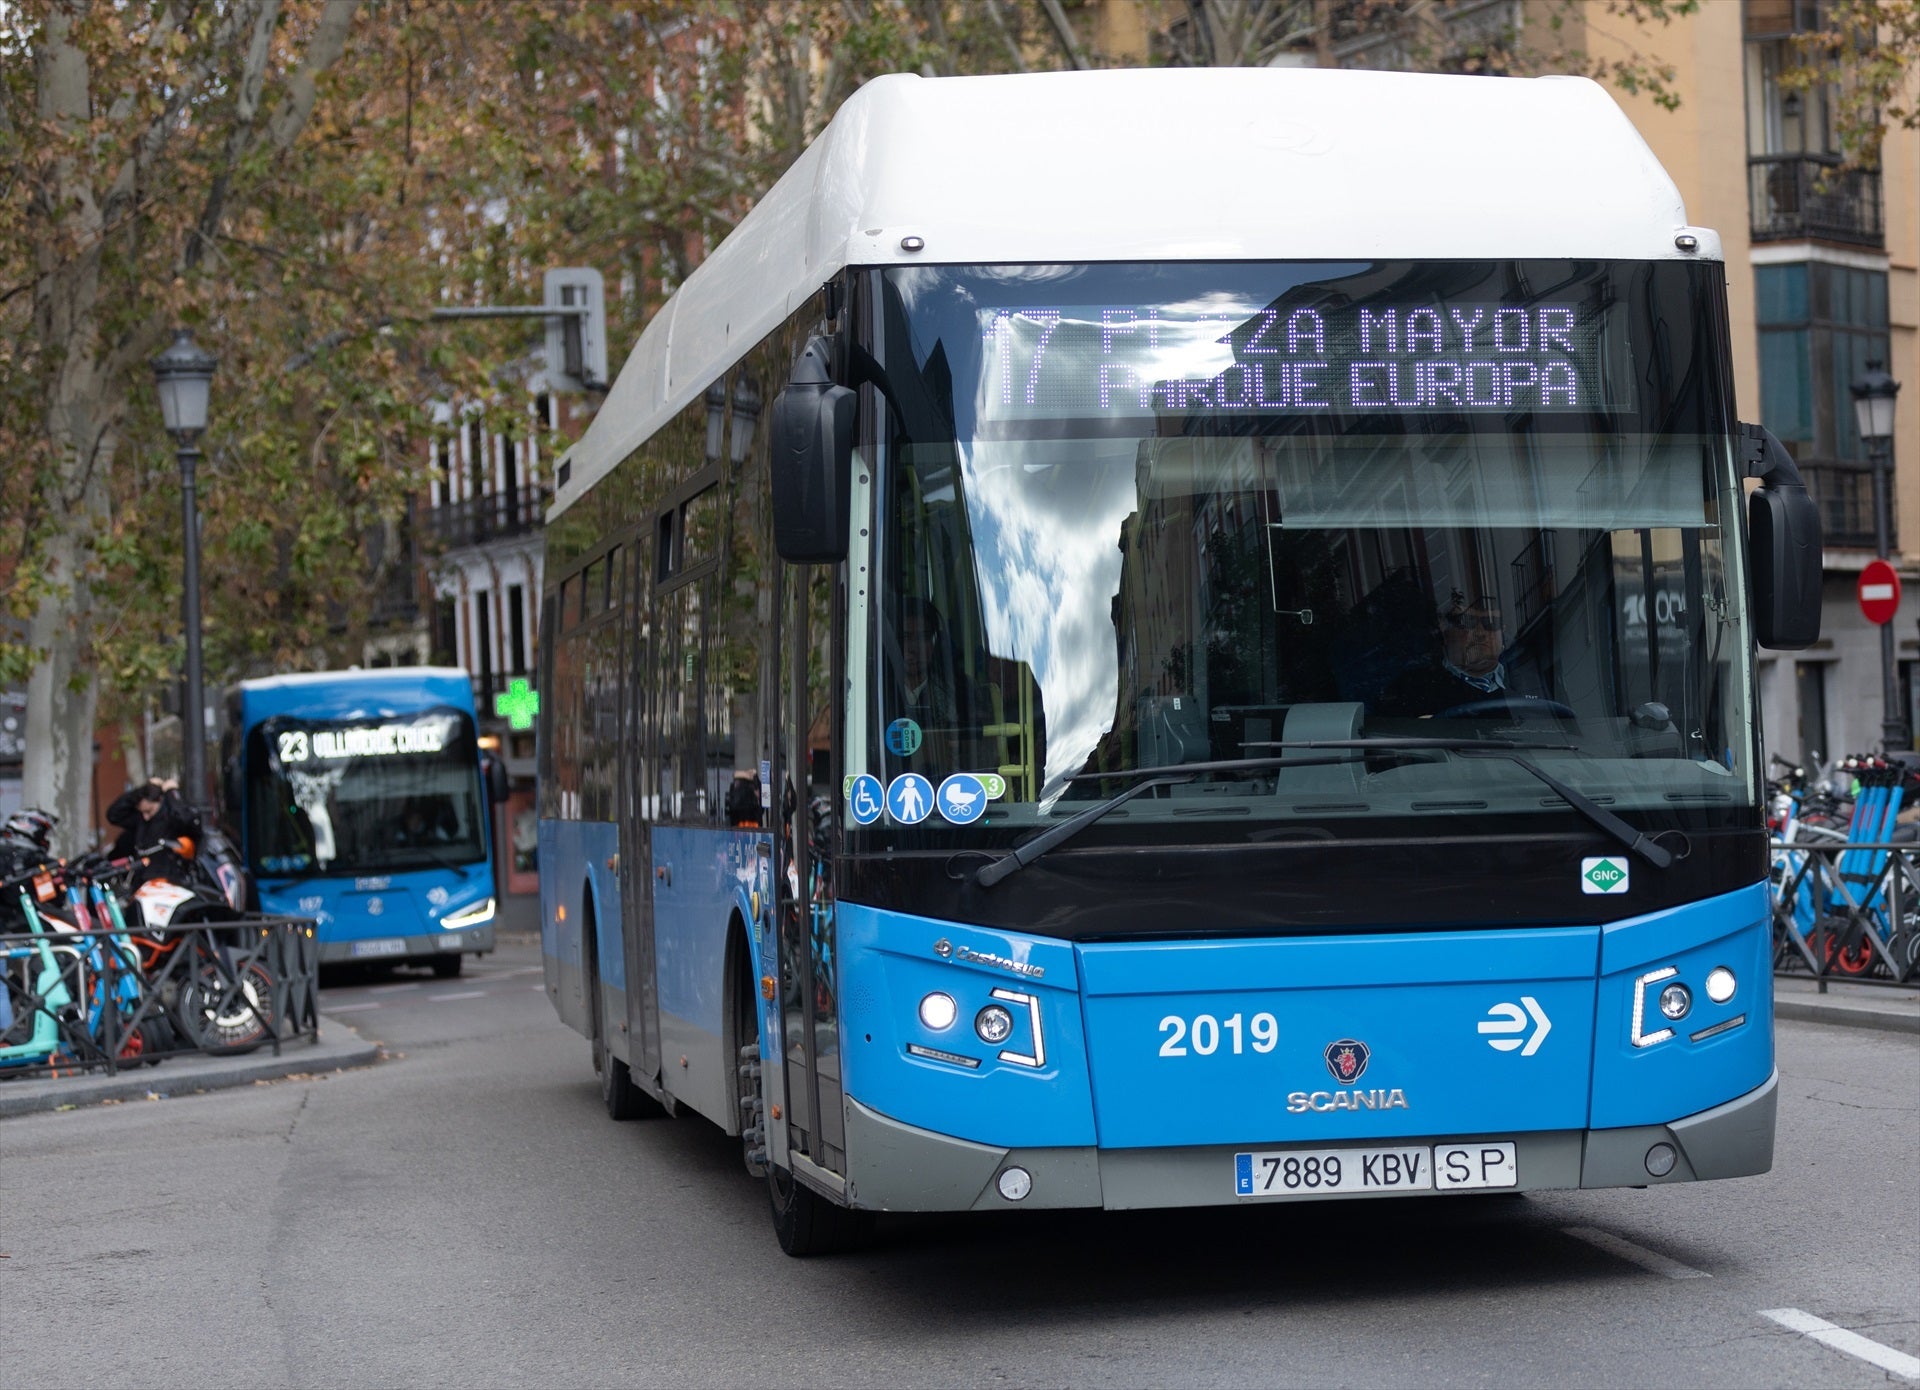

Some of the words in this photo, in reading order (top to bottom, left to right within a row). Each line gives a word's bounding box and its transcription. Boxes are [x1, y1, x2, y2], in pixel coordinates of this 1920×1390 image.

[1361, 309, 1576, 352] MAYOR
[982, 309, 1060, 404] 17
[1100, 362, 1329, 408] PARQUE
[1351, 361, 1577, 407] EUROPA
[279, 731, 309, 762] 23
[989, 778, 999, 792] 3
[1592, 870, 1619, 880] GNC
[955, 945, 1046, 978] Castrosua
[1158, 1012, 1279, 1058] 2019
[1286, 1088, 1410, 1114] SCANIA
[1241, 1178, 1249, 1188] E
[1262, 1156, 1342, 1190] 7889
[1362, 1153, 1421, 1186] KBV
